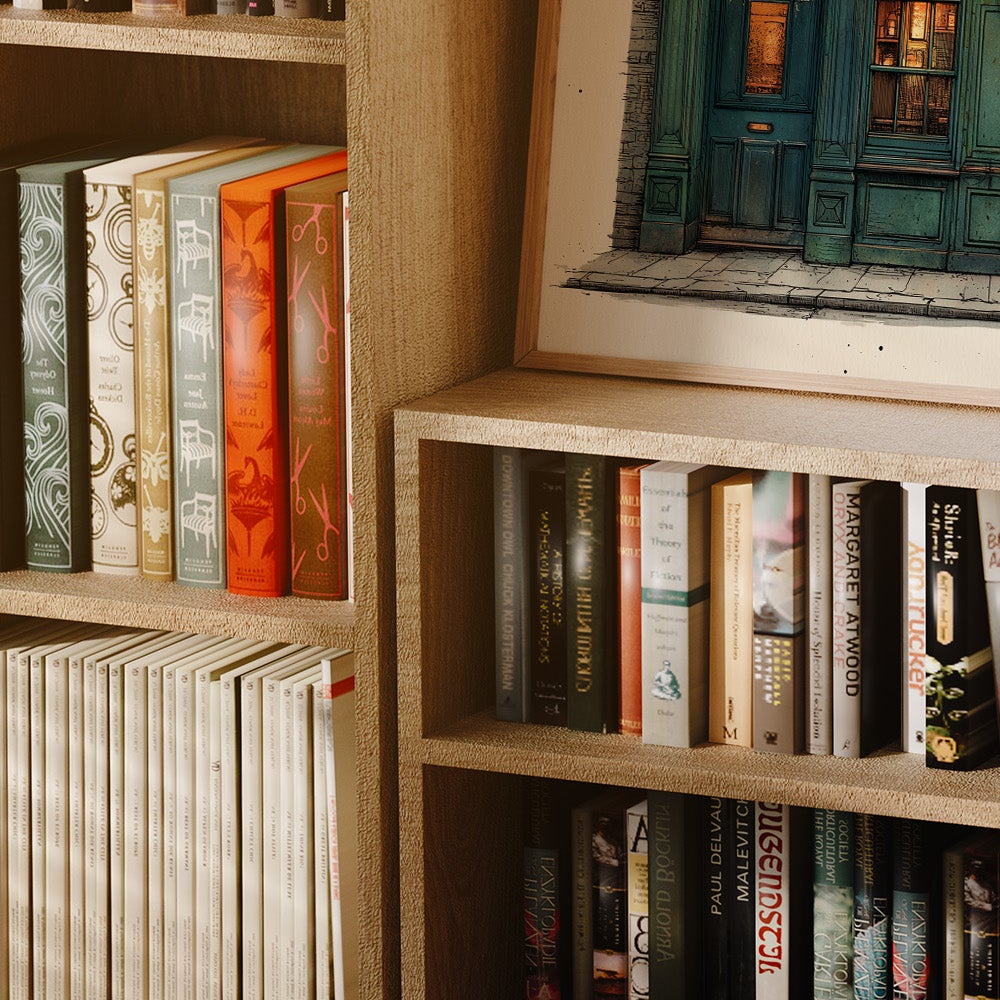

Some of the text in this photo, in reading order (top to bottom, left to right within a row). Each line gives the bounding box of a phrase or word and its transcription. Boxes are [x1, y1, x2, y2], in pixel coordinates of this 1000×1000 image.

[502, 455, 513, 690] DOWNTOWN OWL CHUCK KLOSTERMAN
[834, 492, 845, 669] ORYX AND CRAKE
[846, 493, 860, 697] MARGARET ATWOOD
[710, 871, 722, 916] PAUL
